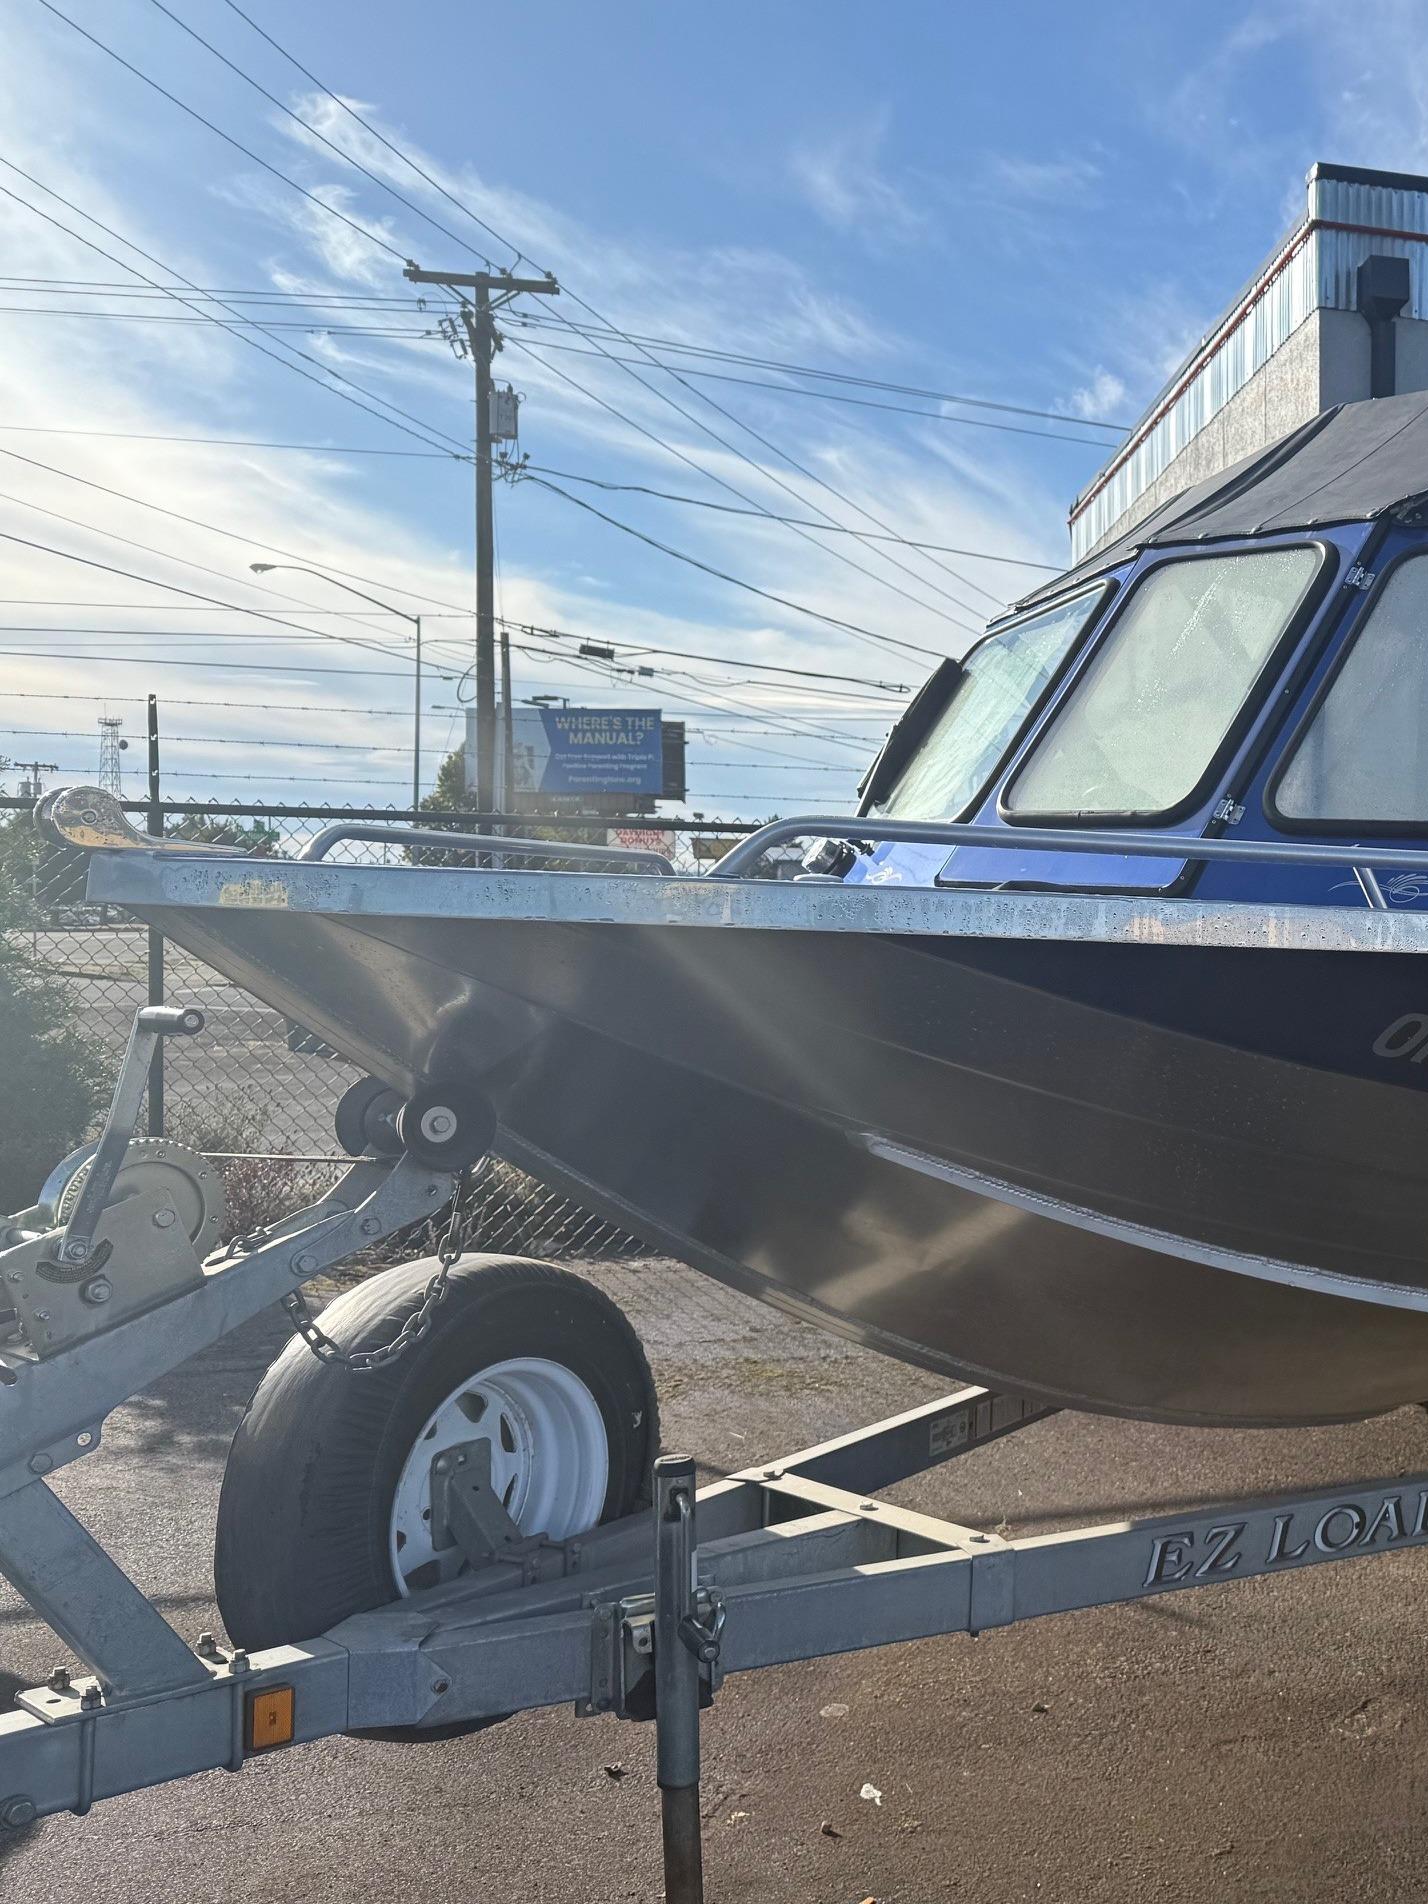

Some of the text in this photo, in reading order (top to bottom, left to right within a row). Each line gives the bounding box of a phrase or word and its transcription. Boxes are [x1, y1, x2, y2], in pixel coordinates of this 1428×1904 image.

[555, 716, 655, 730] WHERE'S THE
[569, 731, 644, 745] MANUAL?
[1142, 1521, 1248, 1588] EZ
